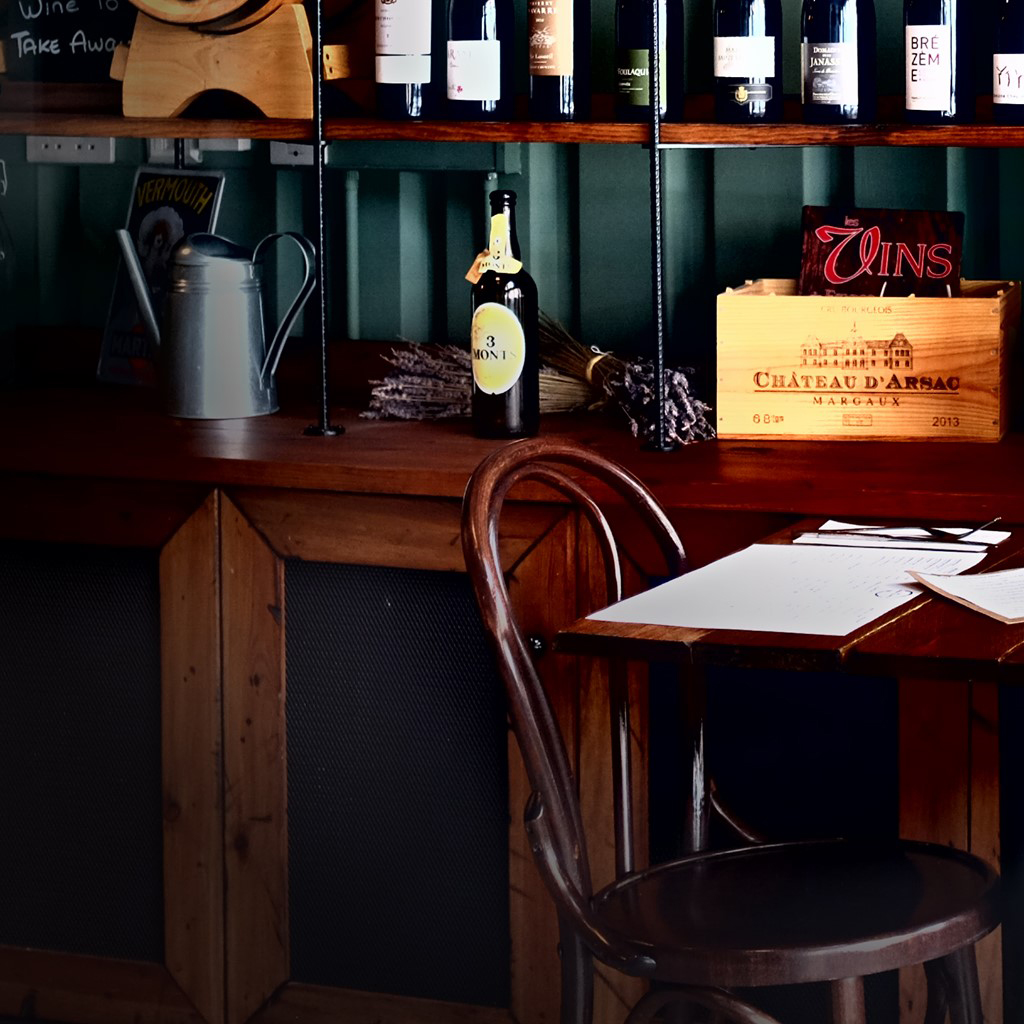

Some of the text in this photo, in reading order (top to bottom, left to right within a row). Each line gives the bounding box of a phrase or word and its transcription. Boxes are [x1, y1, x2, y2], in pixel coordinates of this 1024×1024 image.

[912, 34, 939, 50] BRÉ
[137, 177, 213, 215] VERMOUTH
[486, 335, 496, 348] 3
[753, 371, 961, 391] CHÂTEAU D'ARSAC
[812, 396, 900, 407] MARGAUX
[932, 416, 960, 428] 2013
